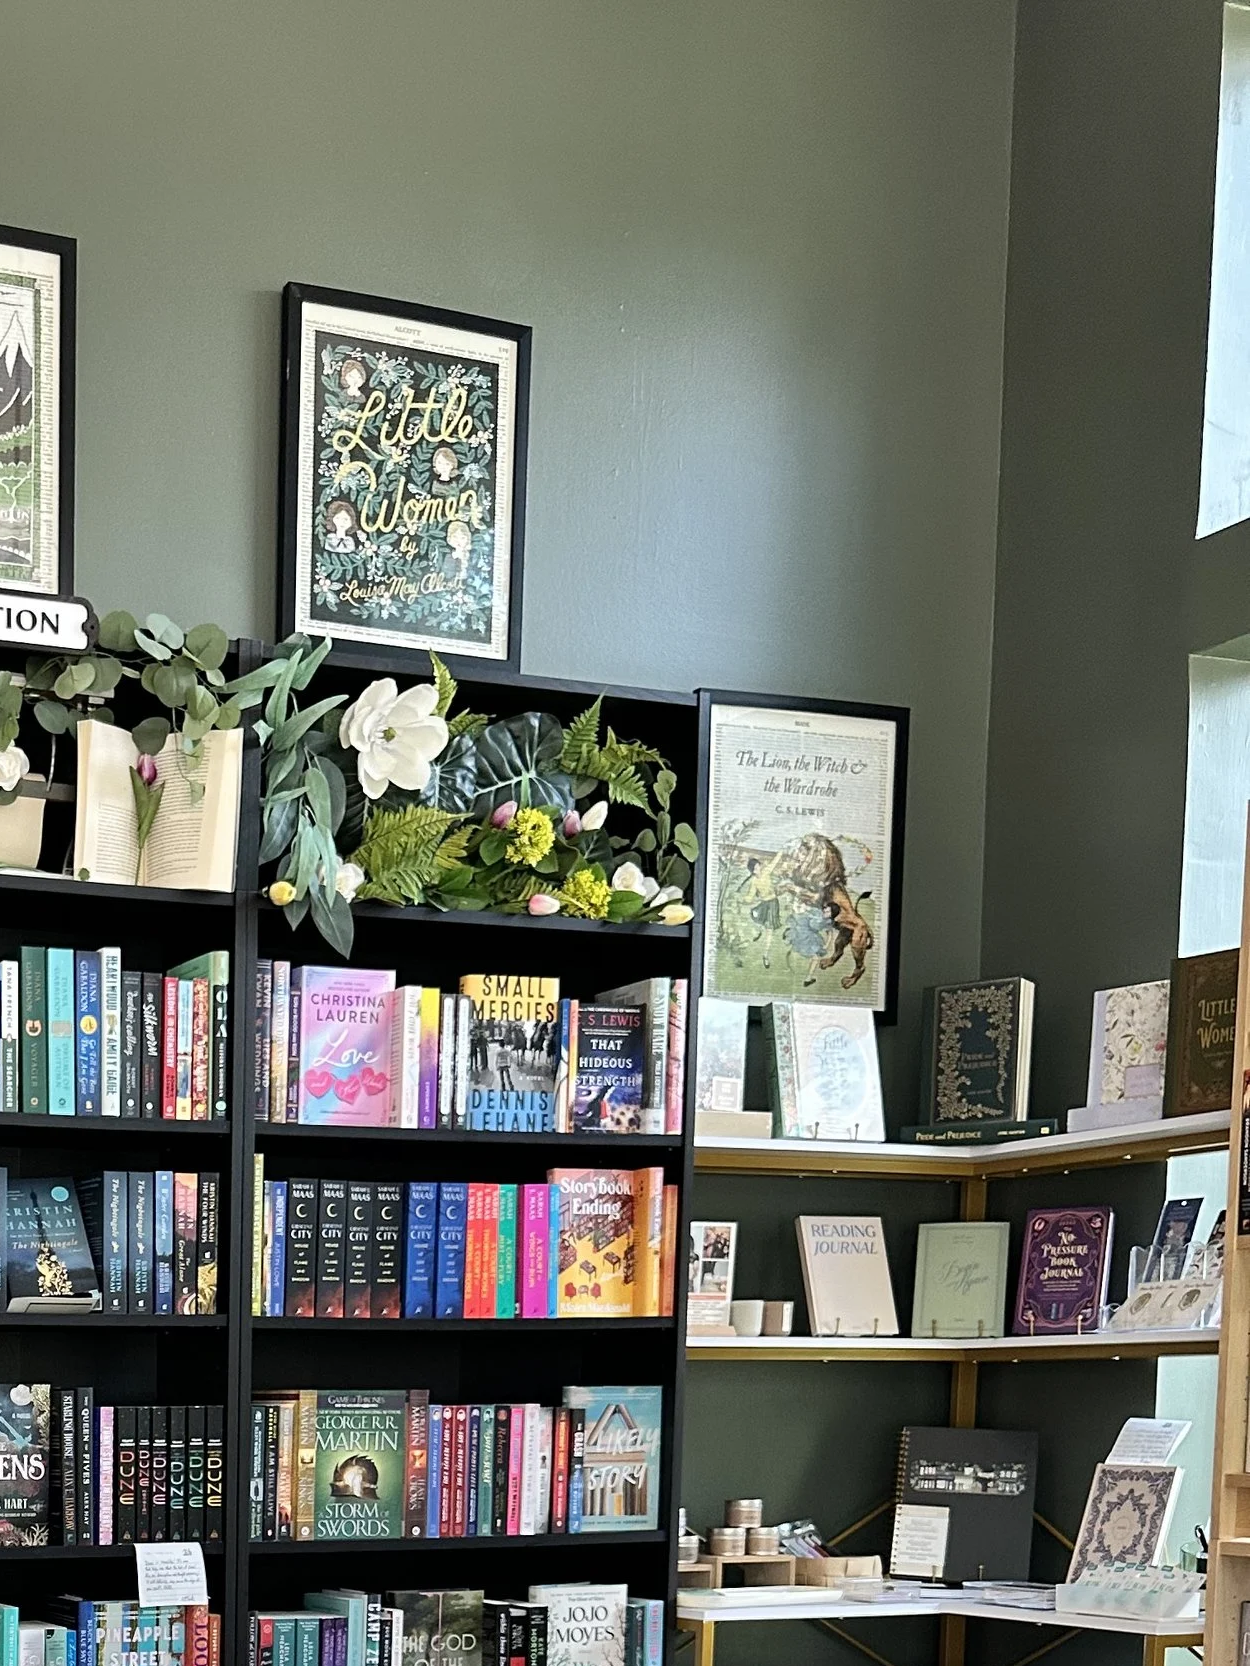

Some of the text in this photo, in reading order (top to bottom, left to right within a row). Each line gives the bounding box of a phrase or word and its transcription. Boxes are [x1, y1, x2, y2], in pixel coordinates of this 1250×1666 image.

[332, 384, 474, 462] Little
[333, 459, 485, 533] Women
[736, 751, 868, 775] The Lion, the Witch &
[763, 777, 839, 798] the Wardrobe
[775, 805, 784, 814] C.
[795, 807, 825, 817] LEWIS
[483, 976, 545, 998] SMALL
[311, 994, 385, 1008] CHRISTINA
[316, 1010, 379, 1024] LAUREN
[473, 1001, 554, 1023] MERCIES
[313, 1028, 380, 1067] Love
[590, 1039, 622, 1051] THAT
[579, 1057, 633, 1069] HIDEOUS
[574, 1075, 636, 1088] STRENGTH
[471, 1090, 548, 1110] DENNIS
[469, 1111, 549, 1132] LEHANE
[560, 1176, 632, 1198] Storybook
[572, 1199, 621, 1220] Ending
[811, 1224, 877, 1239] READING
[813, 1240, 879, 1256] JOURNAL
[1050, 1257, 1077, 1267] BOOK
[315, 1416, 366, 1430] GEORGE
[315, 1432, 398, 1451] MARTIN
[4, 1498, 28, 1510] HART
[325, 1502, 378, 1519] STORM
[317, 1520, 390, 1537] SWORDS
[562, 1606, 608, 1623] JOJO
[95, 1625, 180, 1644] PINEAPPLE
[402, 1633, 477, 1653] THE GOD
[556, 1626, 615, 1646] MOYES
